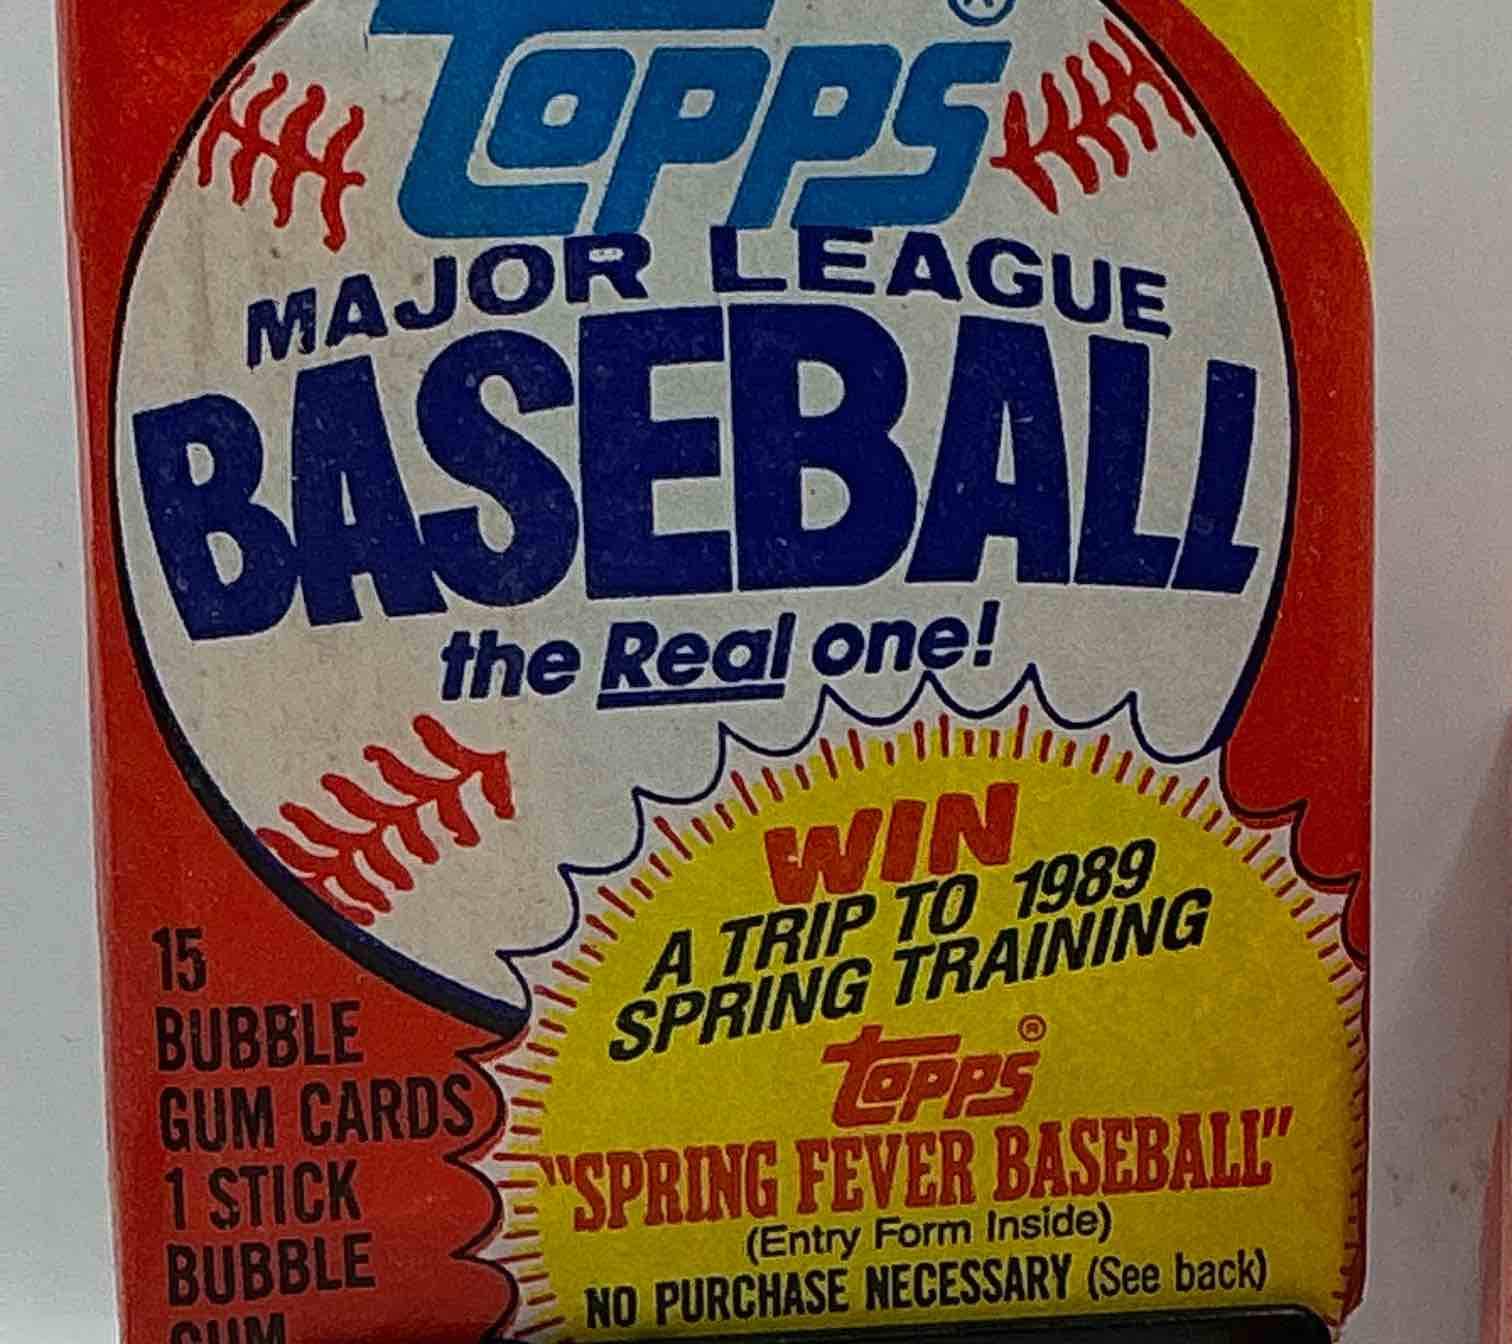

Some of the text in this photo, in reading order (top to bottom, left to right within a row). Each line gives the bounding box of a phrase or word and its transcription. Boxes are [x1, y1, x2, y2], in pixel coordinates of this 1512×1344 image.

[246, 226, 1173, 367] MAJOR LEAGUE
[132, 301, 1258, 642] BASEBALL
[441, 600, 999, 706] the Real one!
[765, 782, 1018, 905] WIN
[152, 927, 207, 991] 15
[644, 838, 1158, 992] A TRIP TO 1989
[609, 887, 1212, 1061] SPRING TRAINING
[155, 1001, 364, 1072] BUBBLE
[159, 1073, 475, 1153] GUM CARDS
[164, 1160, 362, 1230] 1 STICK
[539, 1107, 1293, 1233] "SPRING FEVER BASEBALL"
[167, 1231, 376, 1307] BUBBLE
[746, 1201, 1113, 1265] (Entry Form Inside)
[584, 1250, 1267, 1329] NO PURCHASE NECESSARY (See back)
